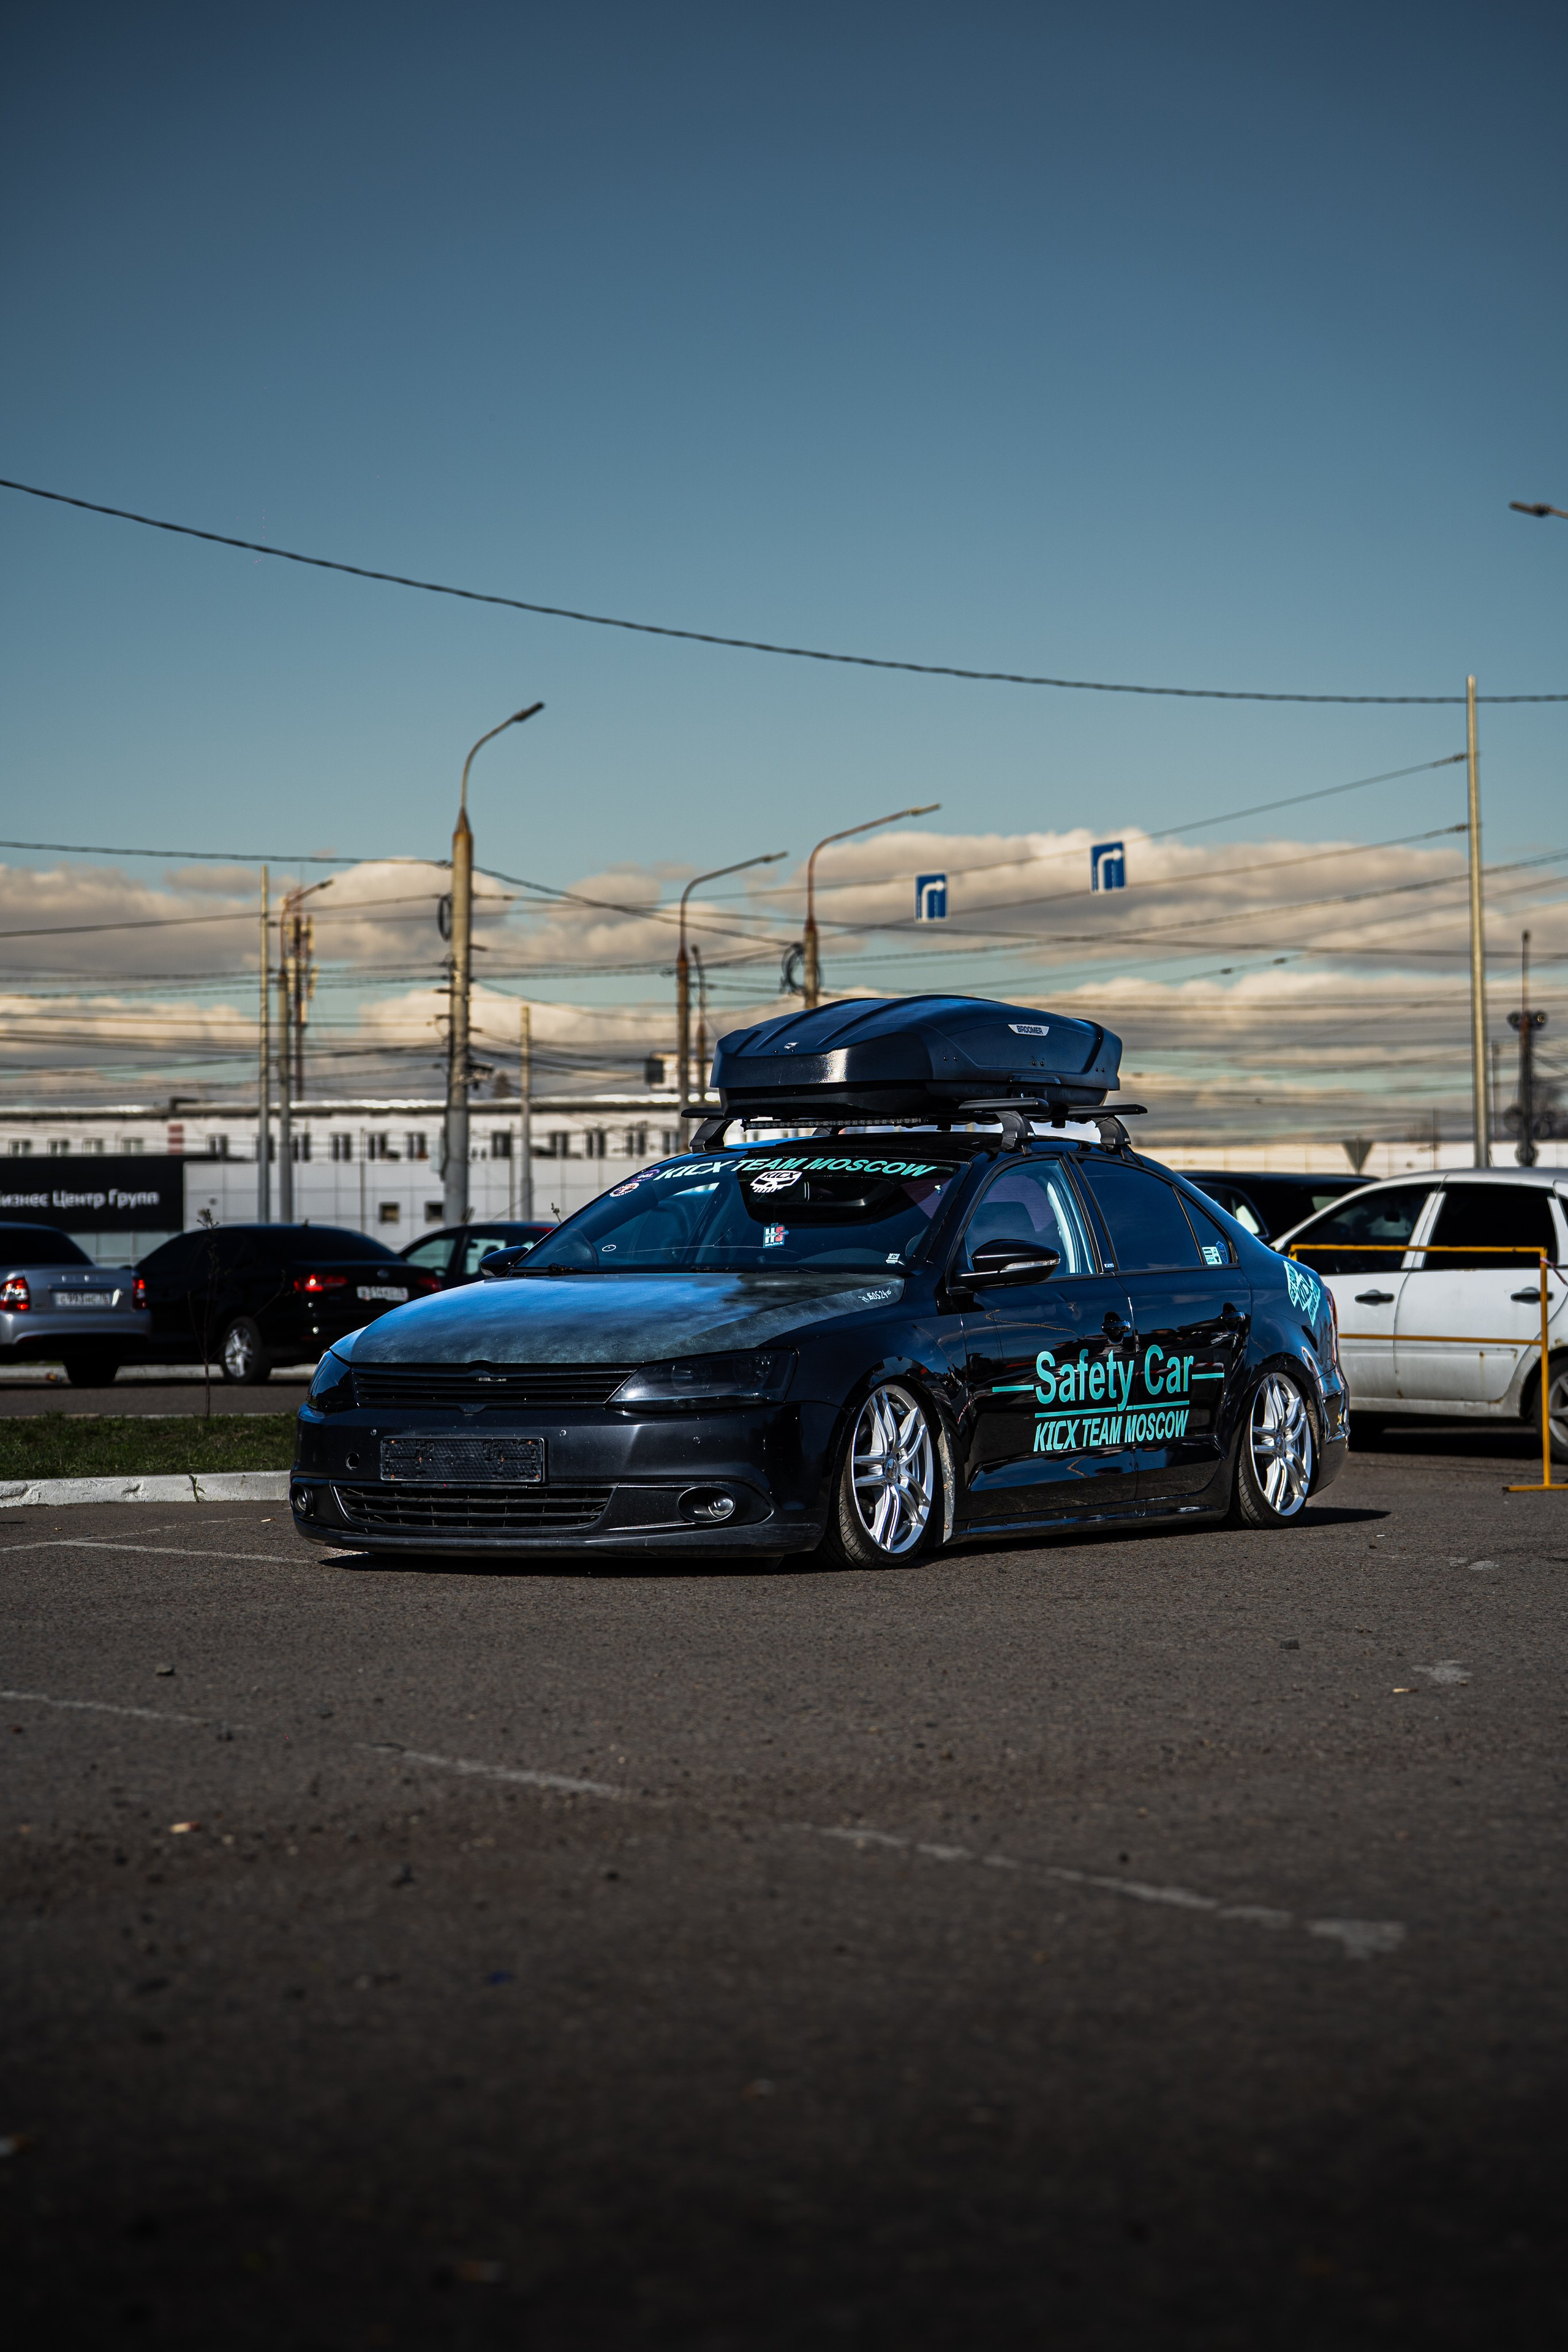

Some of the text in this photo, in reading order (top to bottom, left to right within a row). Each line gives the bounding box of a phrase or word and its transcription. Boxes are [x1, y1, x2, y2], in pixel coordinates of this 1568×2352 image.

[1016, 1025, 1043, 1035] BROOMER
[653, 1158, 937, 1181] KICX TEAM MOSCOW
[0, 1188, 159, 1210] изнес Центр Групп
[1297, 1277, 1314, 1308] KICX
[1035, 1344, 1194, 1411] Safety Car
[1033, 1409, 1189, 1452] KICX TEAM MOSCOW
